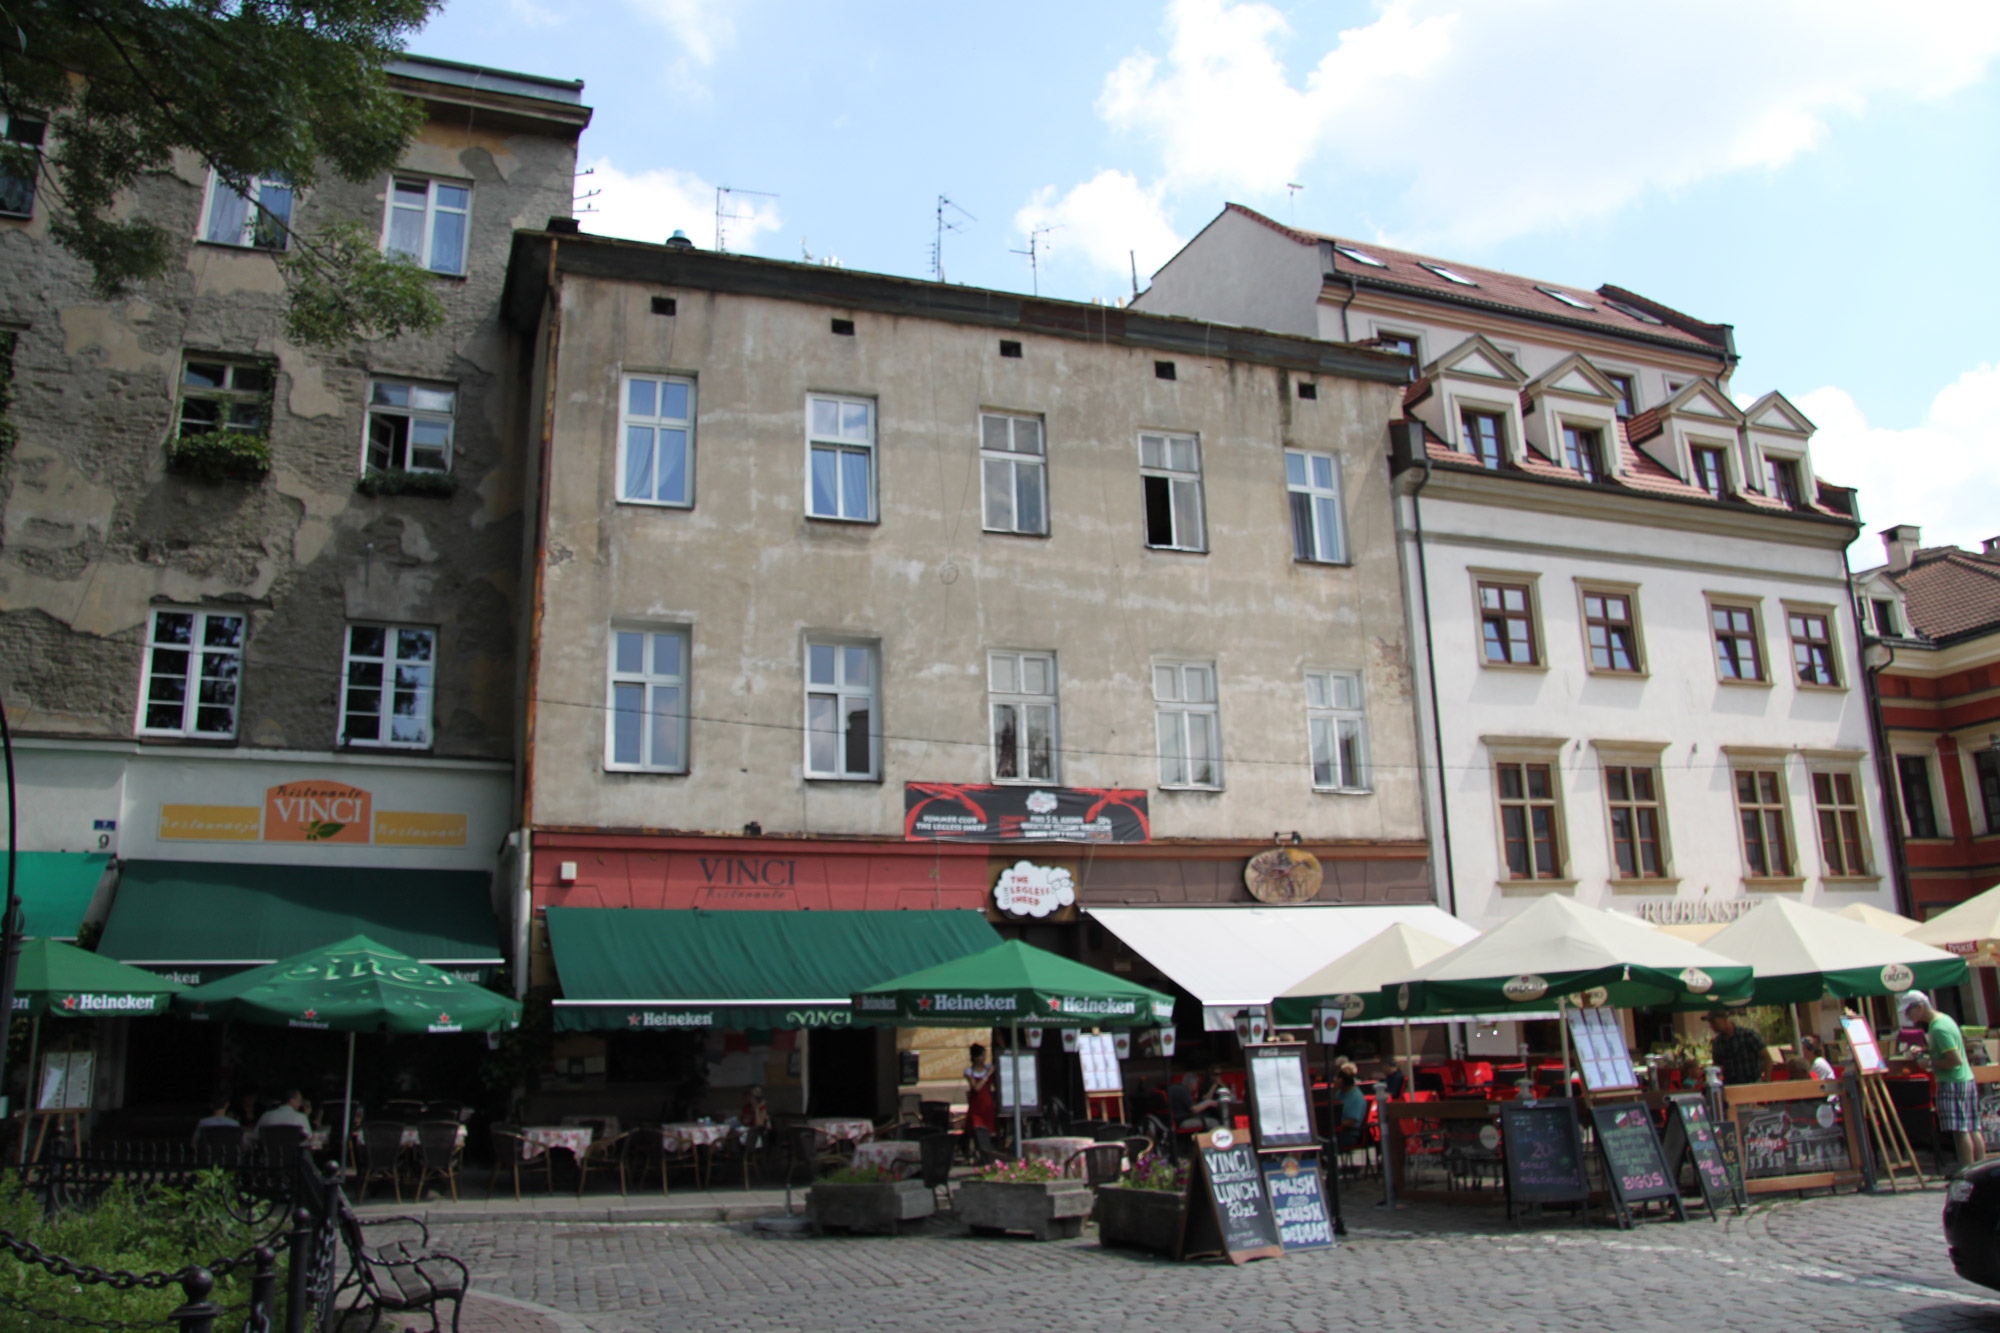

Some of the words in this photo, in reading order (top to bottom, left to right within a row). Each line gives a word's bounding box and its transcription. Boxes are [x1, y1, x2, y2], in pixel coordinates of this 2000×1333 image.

[275, 799, 362, 823] VINCI
[98, 833, 110, 850] 9
[698, 858, 796, 887] VINCI
[1010, 876, 1028, 884] THE
[80, 994, 156, 1010] Heineken
[935, 994, 1017, 1012] Heineken
[1063, 998, 1136, 1015] Heineken
[643, 1011, 713, 1027] Heineken
[1205, 1150, 1251, 1174] VINCI
[1269, 1174, 1318, 1197] POLISH
[1622, 1171, 1664, 1190] BIGOS
[1213, 1181, 1260, 1204] LUNCH
